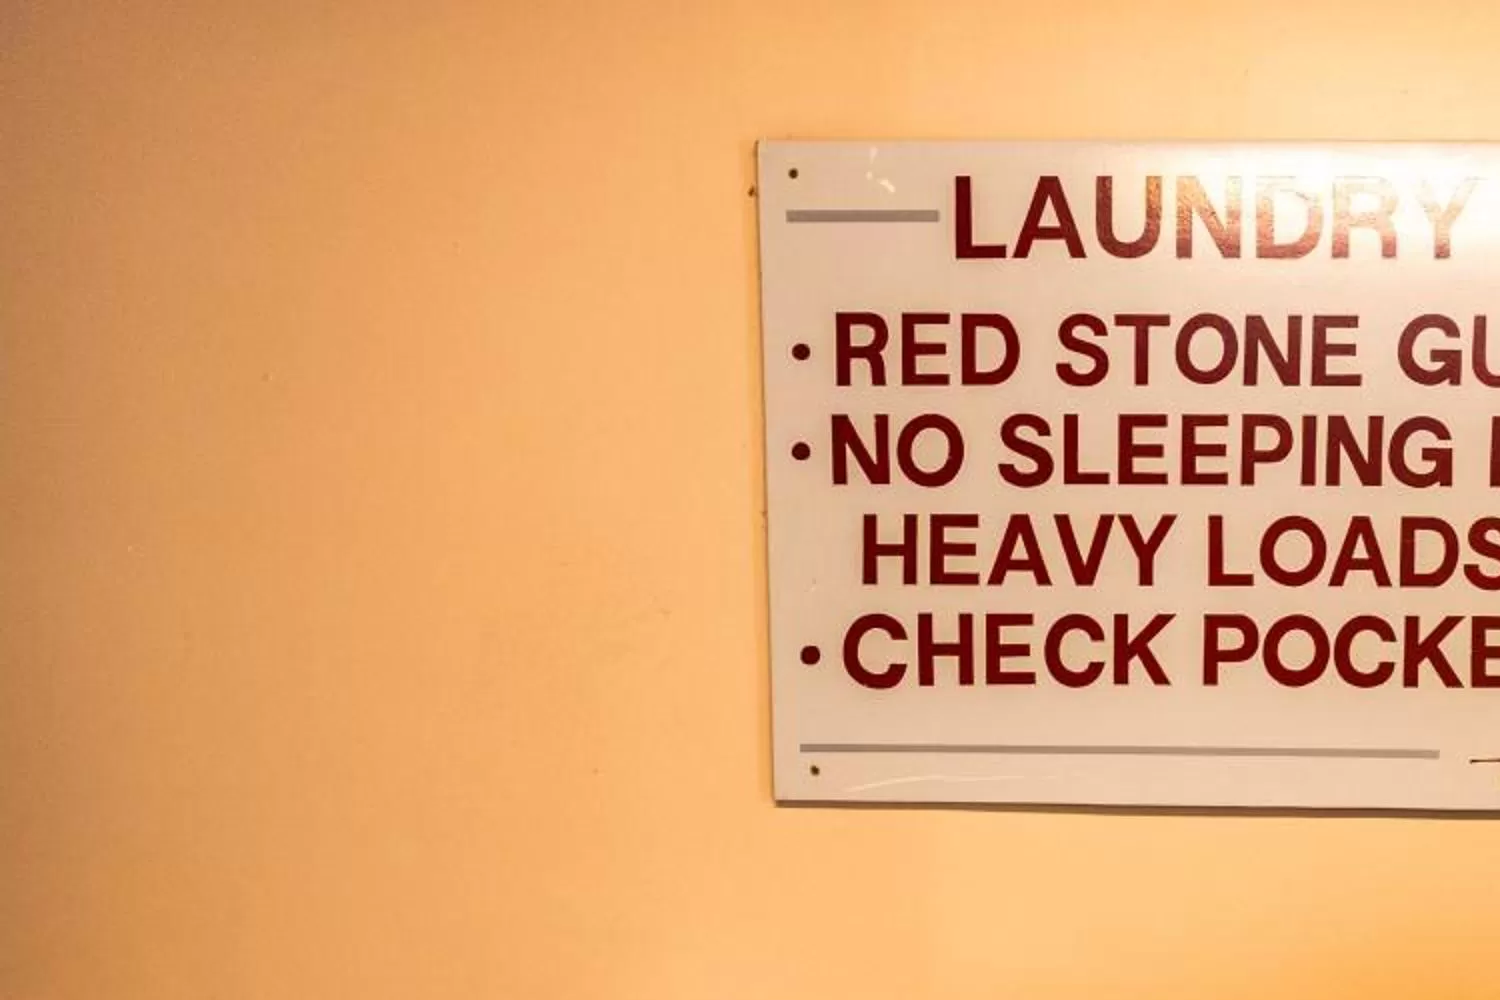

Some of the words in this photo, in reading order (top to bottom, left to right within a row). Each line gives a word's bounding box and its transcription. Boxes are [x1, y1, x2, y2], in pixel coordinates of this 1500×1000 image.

[955, 174, 1476, 260] LAUNDRY
[836, 312, 1020, 386] RED
[1056, 314, 1361, 386] STONE
[831, 414, 964, 488] NO
[998, 414, 1452, 488] SLEEPING
[862, 514, 1177, 586] HEAVY
[843, 613, 1176, 689] CHECK
